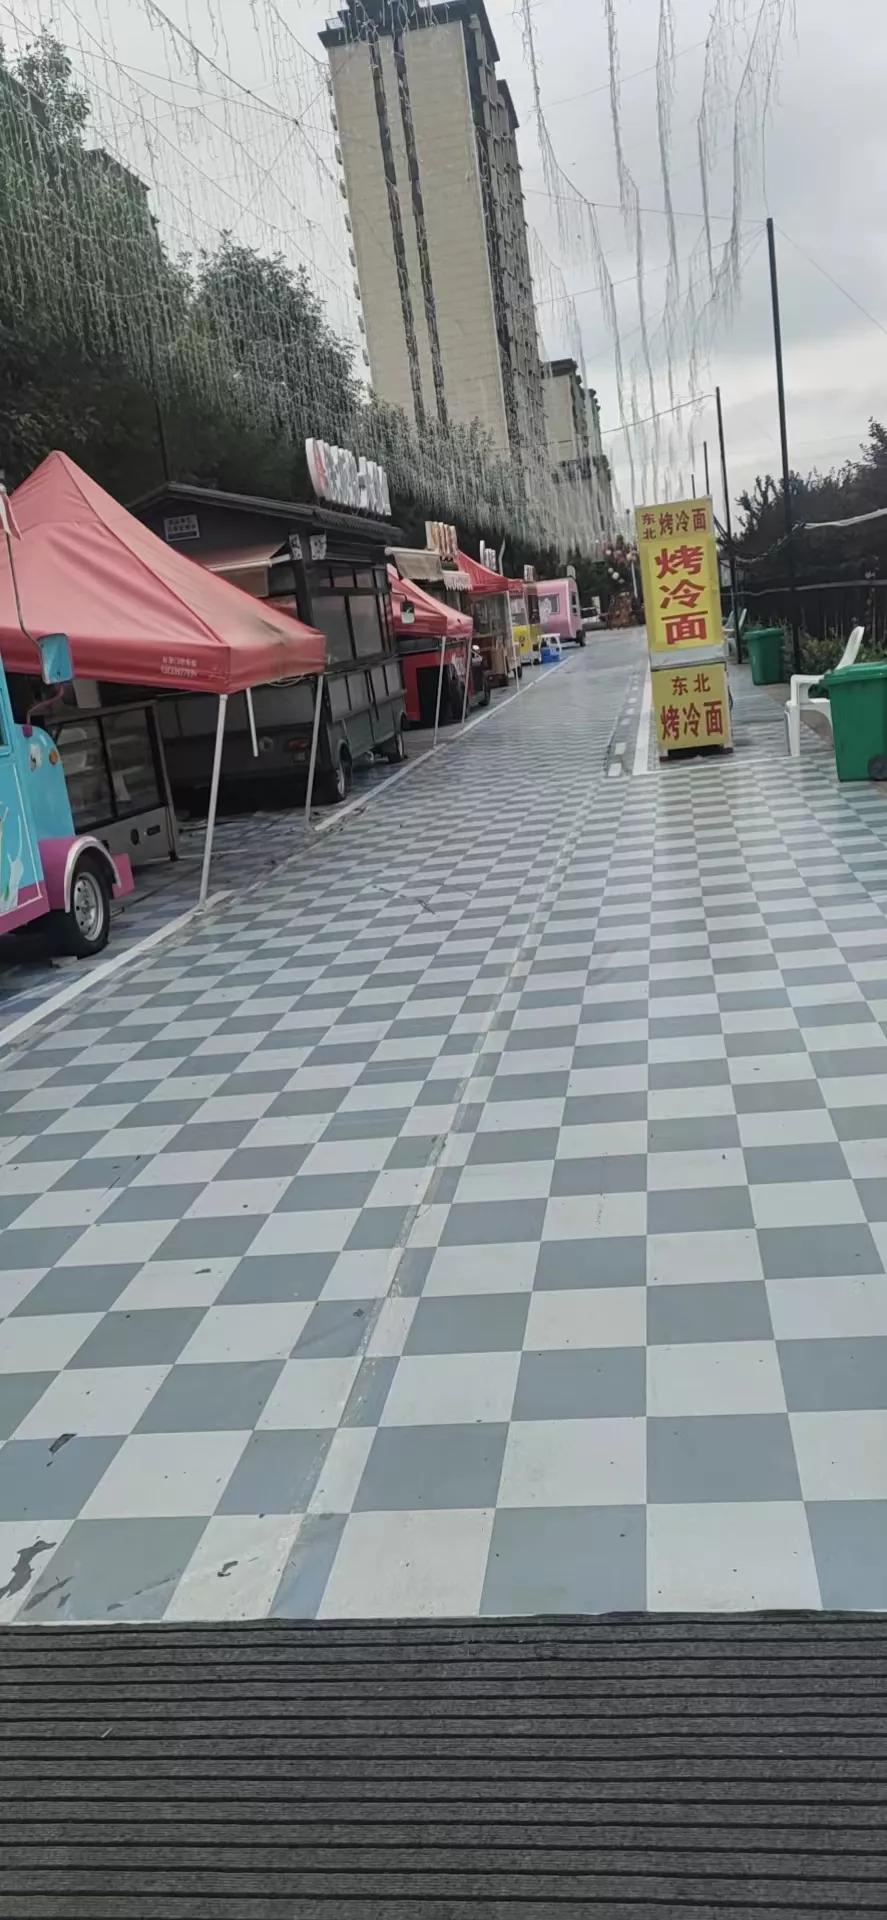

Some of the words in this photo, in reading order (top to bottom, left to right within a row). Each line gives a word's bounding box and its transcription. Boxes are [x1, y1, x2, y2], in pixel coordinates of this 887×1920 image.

[641, 512, 656, 540] 东北
[659, 508, 707, 536] 烤冷面
[655, 545, 708, 645] 烤冷面
[671, 673, 711, 695] 东北
[660, 700, 723, 740] 烤冷面
